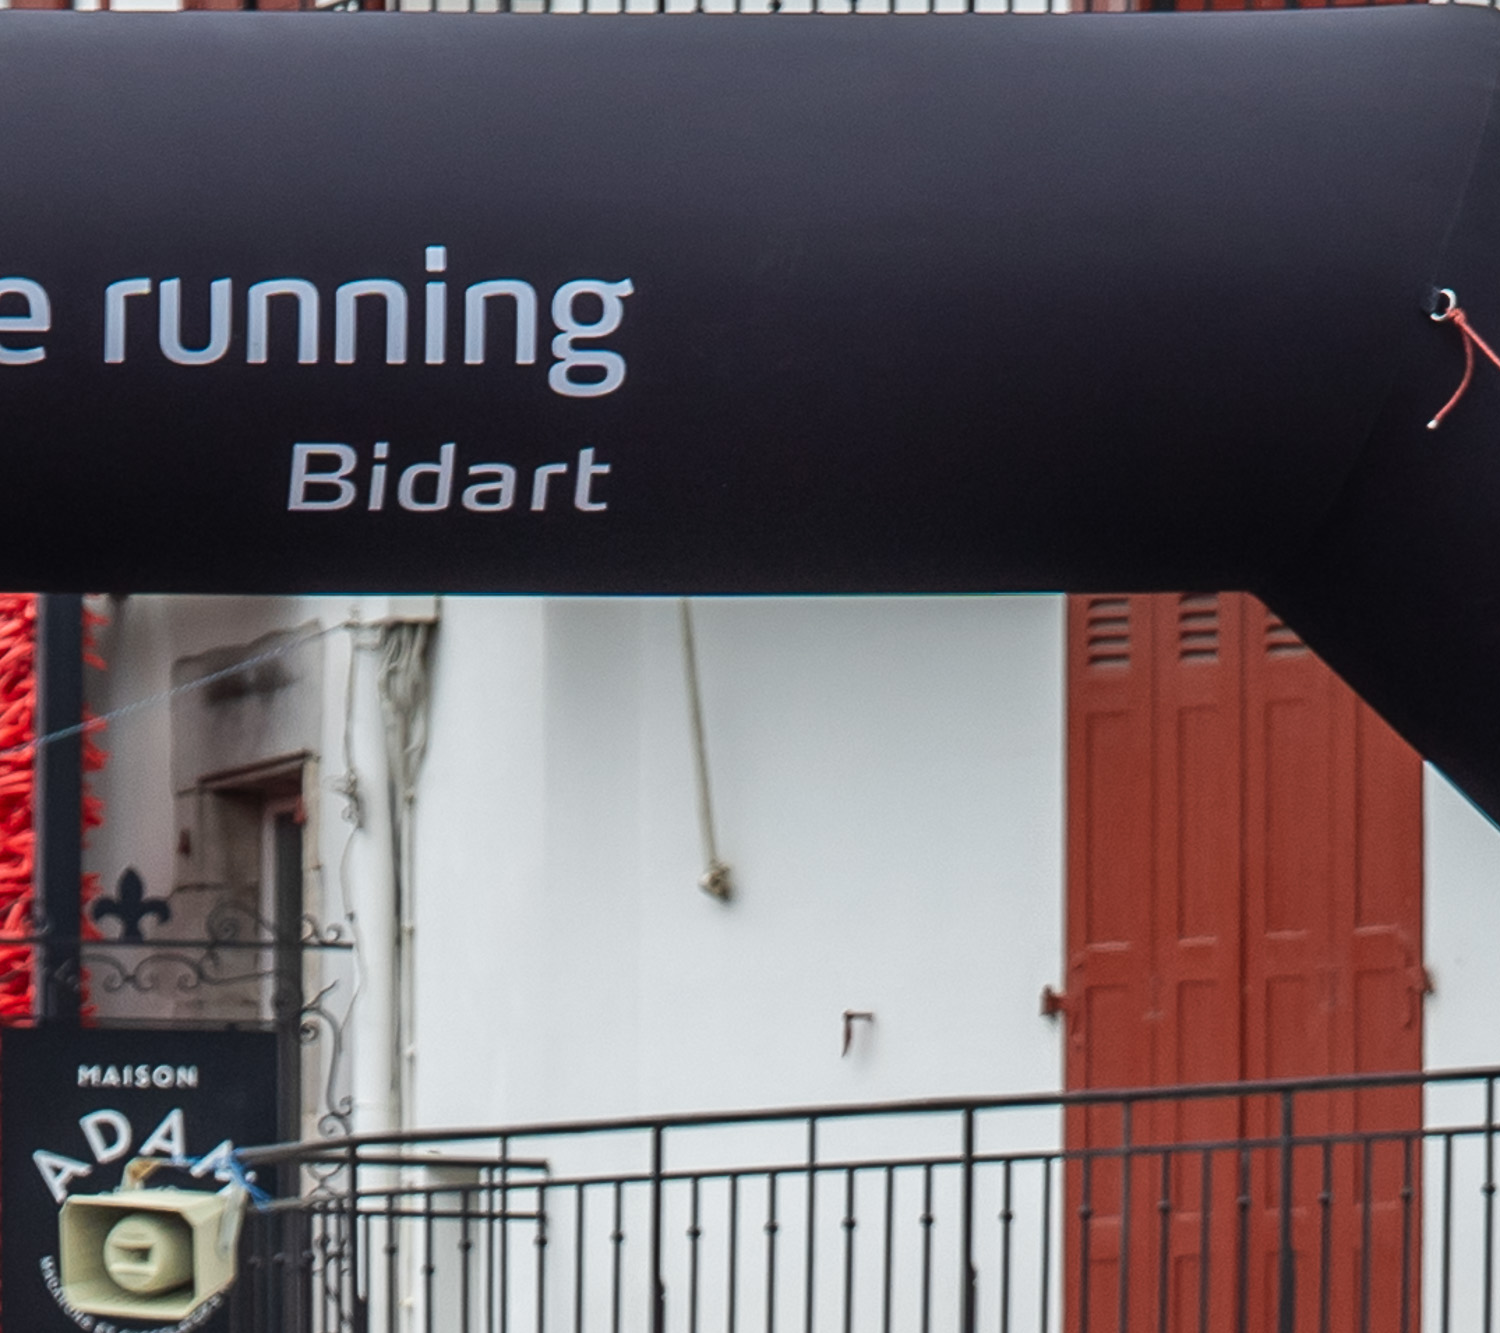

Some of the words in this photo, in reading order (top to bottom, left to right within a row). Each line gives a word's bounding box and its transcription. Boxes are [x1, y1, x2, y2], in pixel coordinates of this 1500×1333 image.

[101, 246, 634, 396] running
[287, 441, 610, 512] Bidart
[77, 1063, 197, 1087] MAISON
